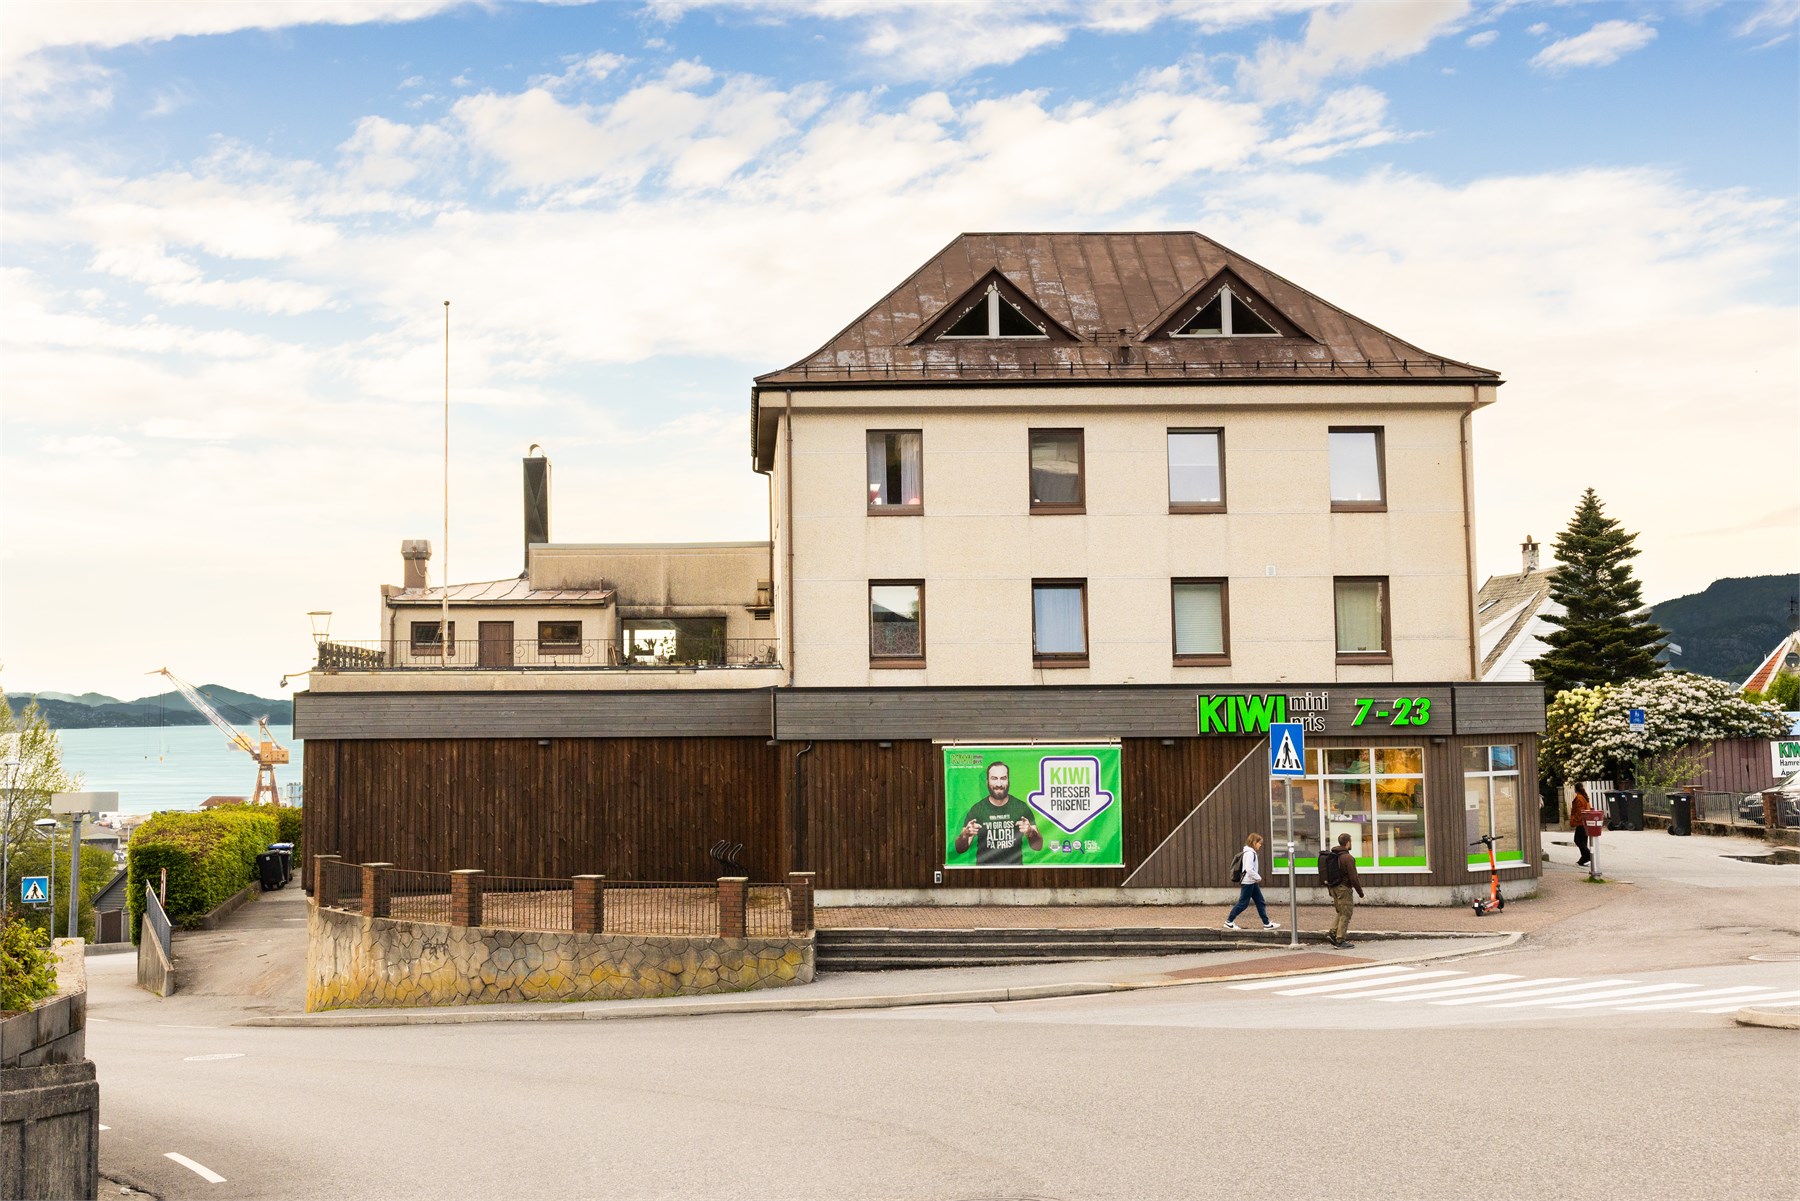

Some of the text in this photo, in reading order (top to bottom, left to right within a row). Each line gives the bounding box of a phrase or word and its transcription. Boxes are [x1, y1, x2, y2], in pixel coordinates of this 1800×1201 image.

[1290, 692, 1328, 711] mini
[1197, 695, 1286, 733] KIWI
[1050, 767, 1090, 785] KIWI
[1050, 786, 1090, 798] PRESSER
[1050, 799, 1091, 811] PRISENE!
[993, 821, 1003, 830] GIR
[1003, 820, 1015, 829] OSS
[987, 828, 1014, 841] ALDRI
